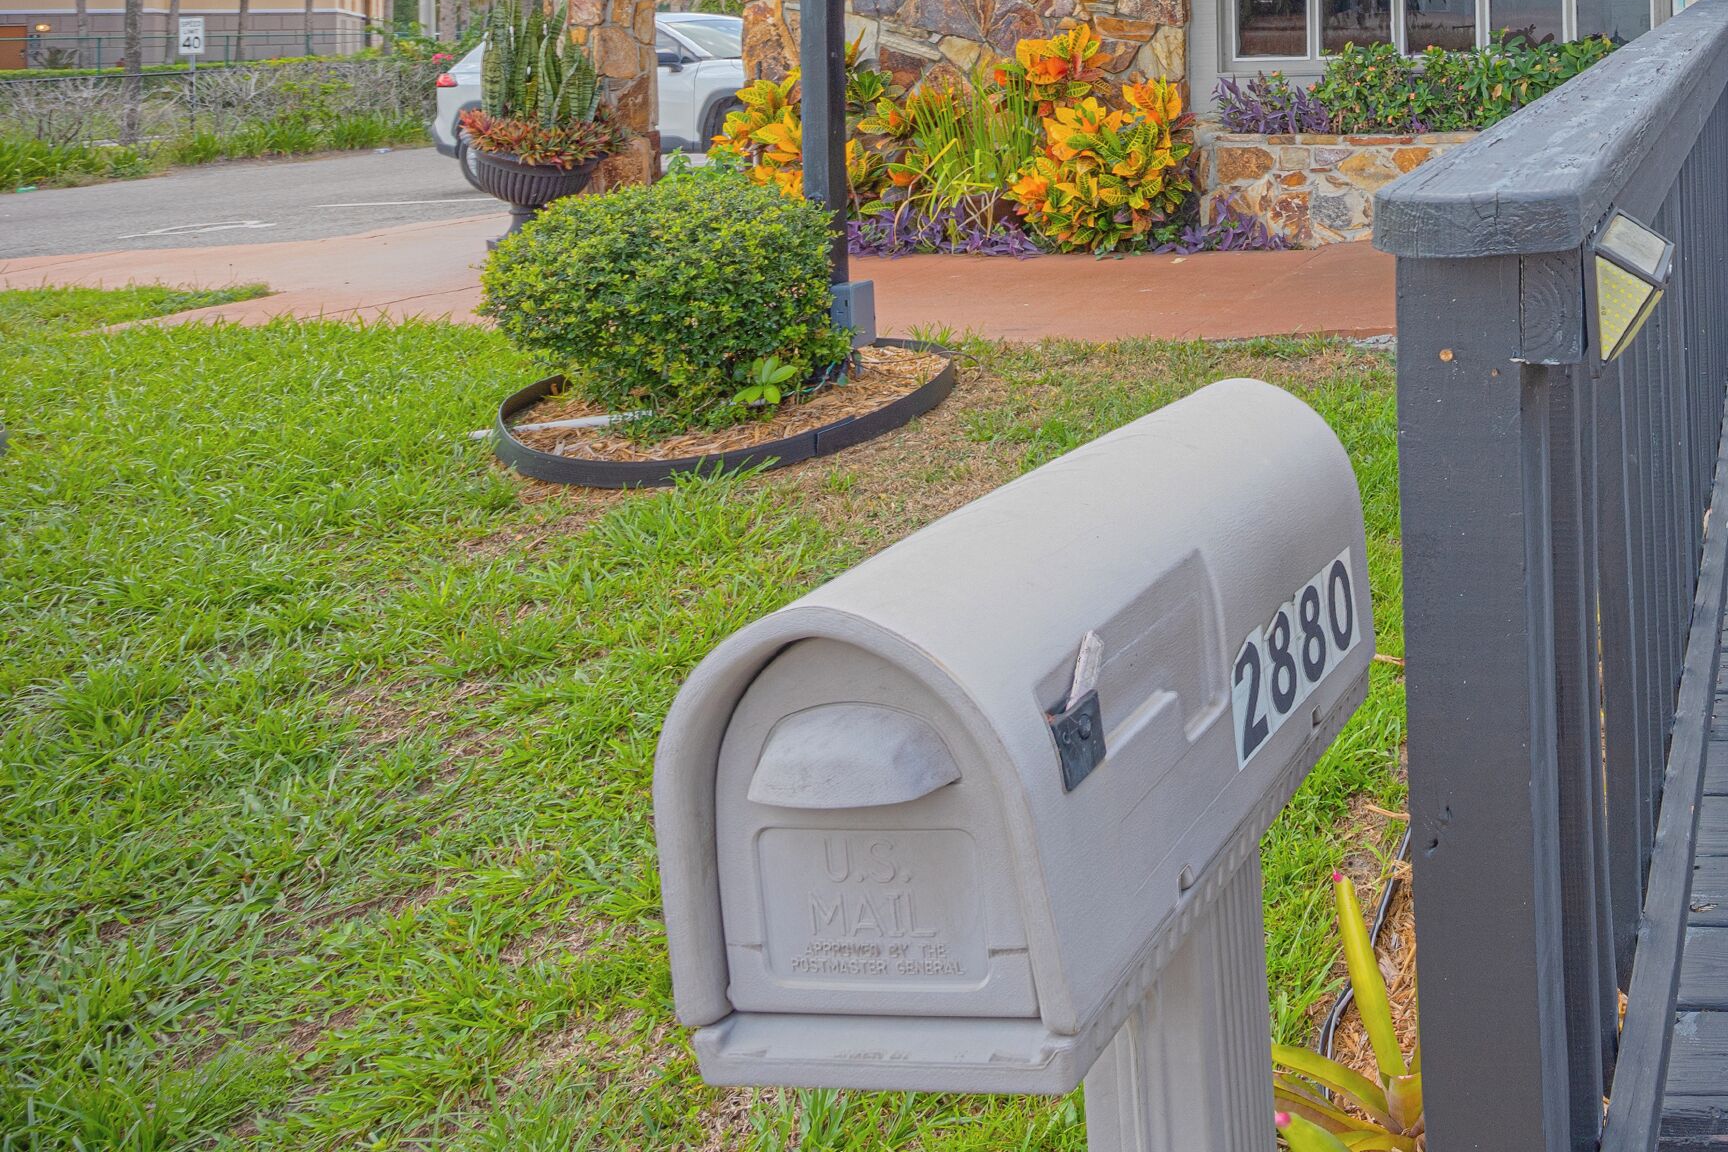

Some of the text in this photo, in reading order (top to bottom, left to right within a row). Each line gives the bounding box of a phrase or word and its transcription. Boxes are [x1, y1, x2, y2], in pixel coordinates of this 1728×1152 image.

[182, 36, 201, 49] 40
[1234, 559, 1354, 761] 2880
[823, 837, 912, 884] U.S.
[808, 890, 937, 938] MAIL
[791, 957, 967, 976] POSTMASTER GENERAL
[804, 941, 949, 959] APPROVED BY THE
